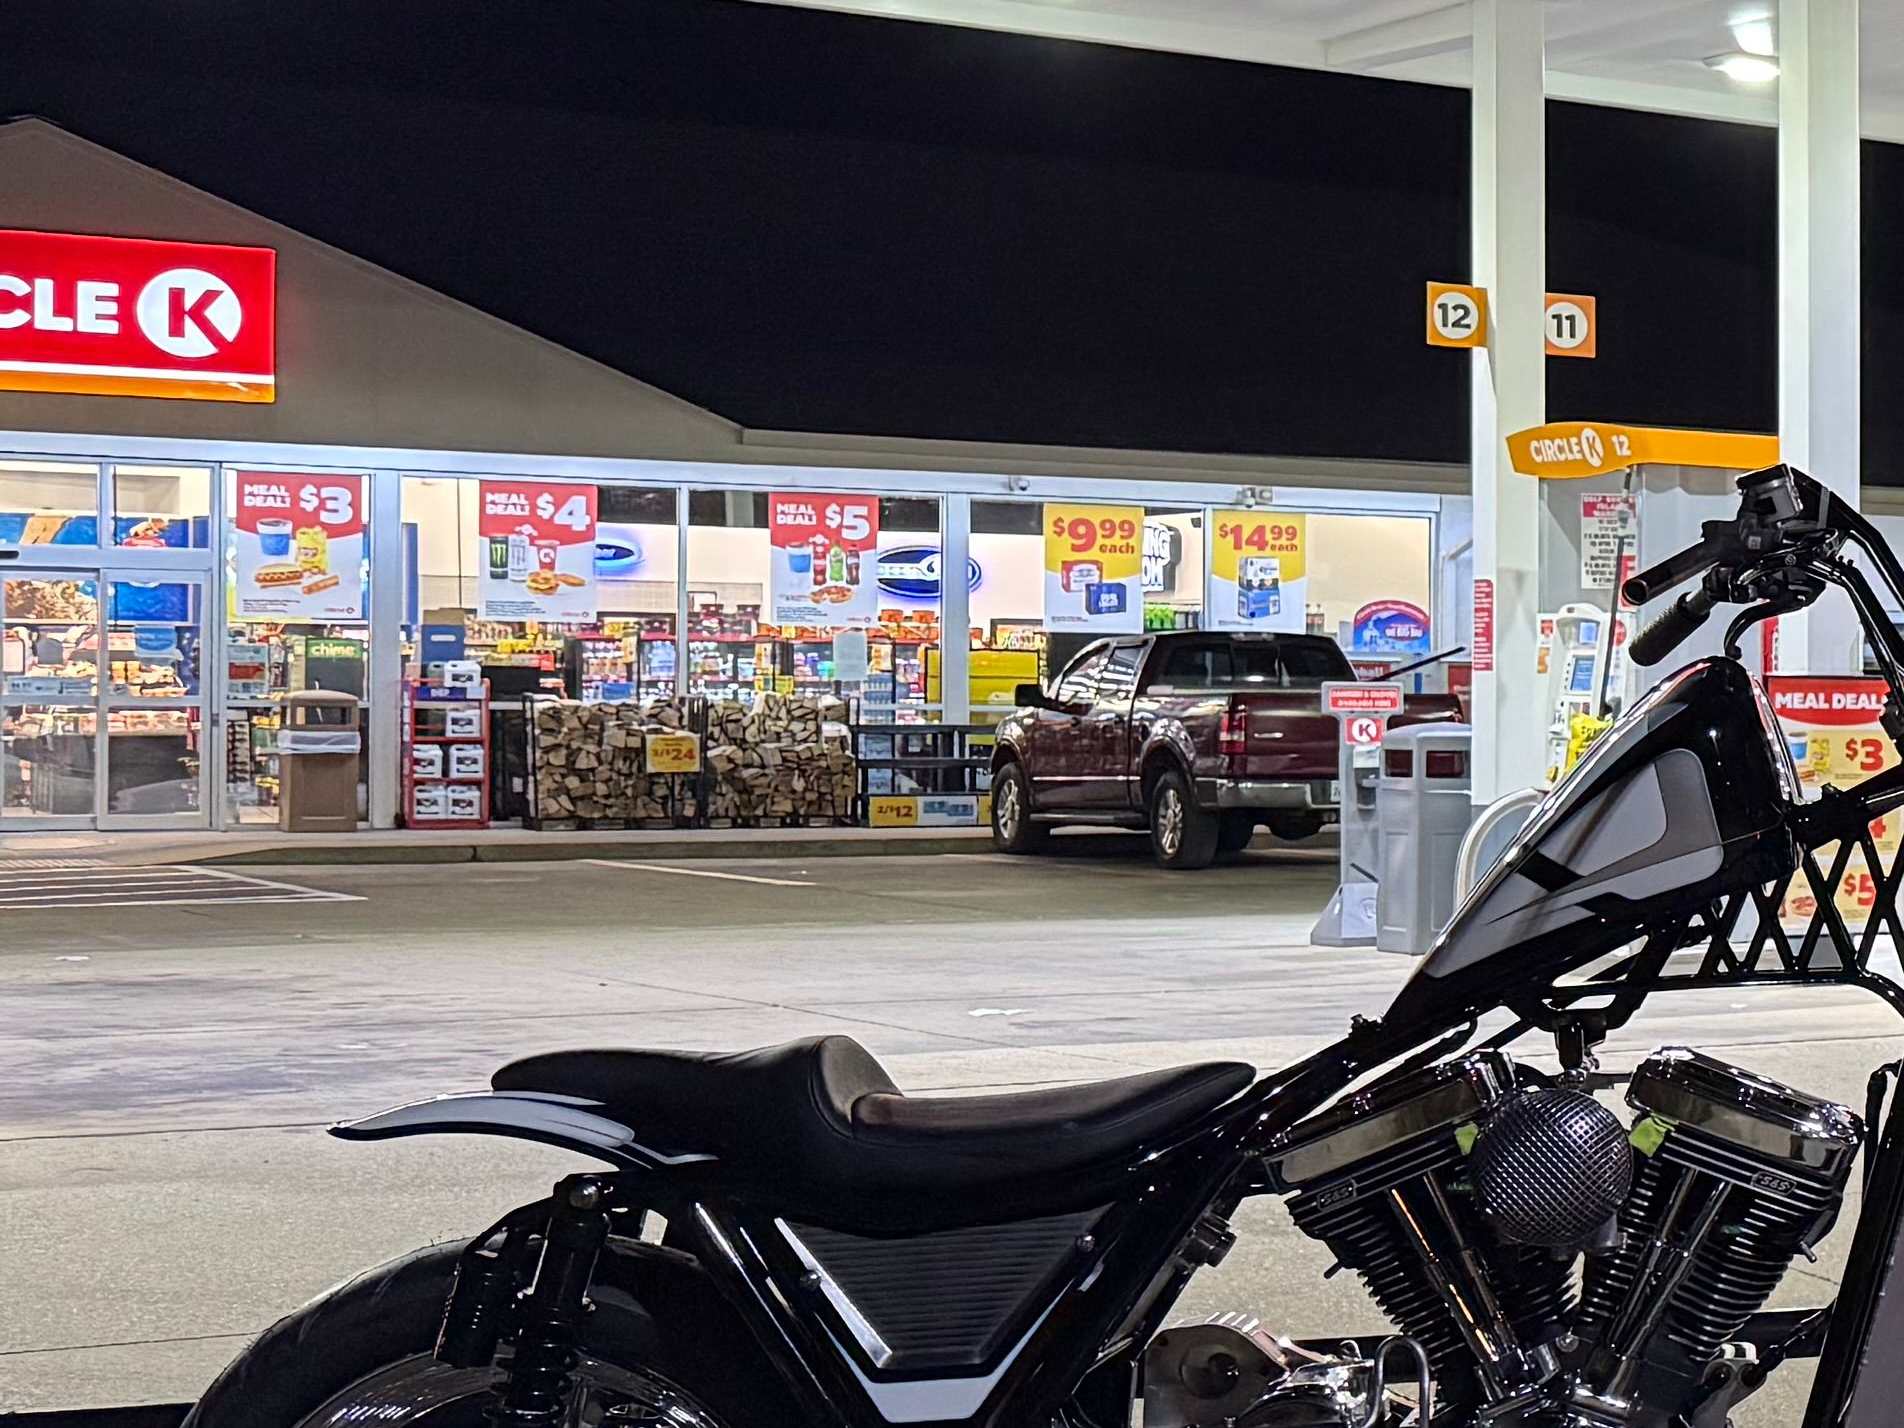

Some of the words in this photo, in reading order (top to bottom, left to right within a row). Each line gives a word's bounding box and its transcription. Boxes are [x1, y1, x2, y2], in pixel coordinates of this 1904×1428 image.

[168, 286, 229, 349] K
[1437, 303, 1472, 329] 12
[1552, 314, 1576, 339] 11
[1530, 437, 1583, 463] CIRCLE
[1583, 432, 1603, 463] K
[1611, 435, 1632, 457] 12
[244, 484, 289, 496] MEAL
[486, 493, 528, 504] MEAL
[299, 484, 353, 524] $3
[536, 493, 590, 531] $4
[776, 503, 815, 514] MEAL
[825, 503, 870, 540] $5
[1099, 543, 1135, 554] each
[1270, 543, 1298, 552] each
[311, 644, 355, 656] chime
[1775, 692, 1830, 710] MEAL
[1845, 738, 1884, 771] $3
[1760, 1175, 1790, 1190] S&S
